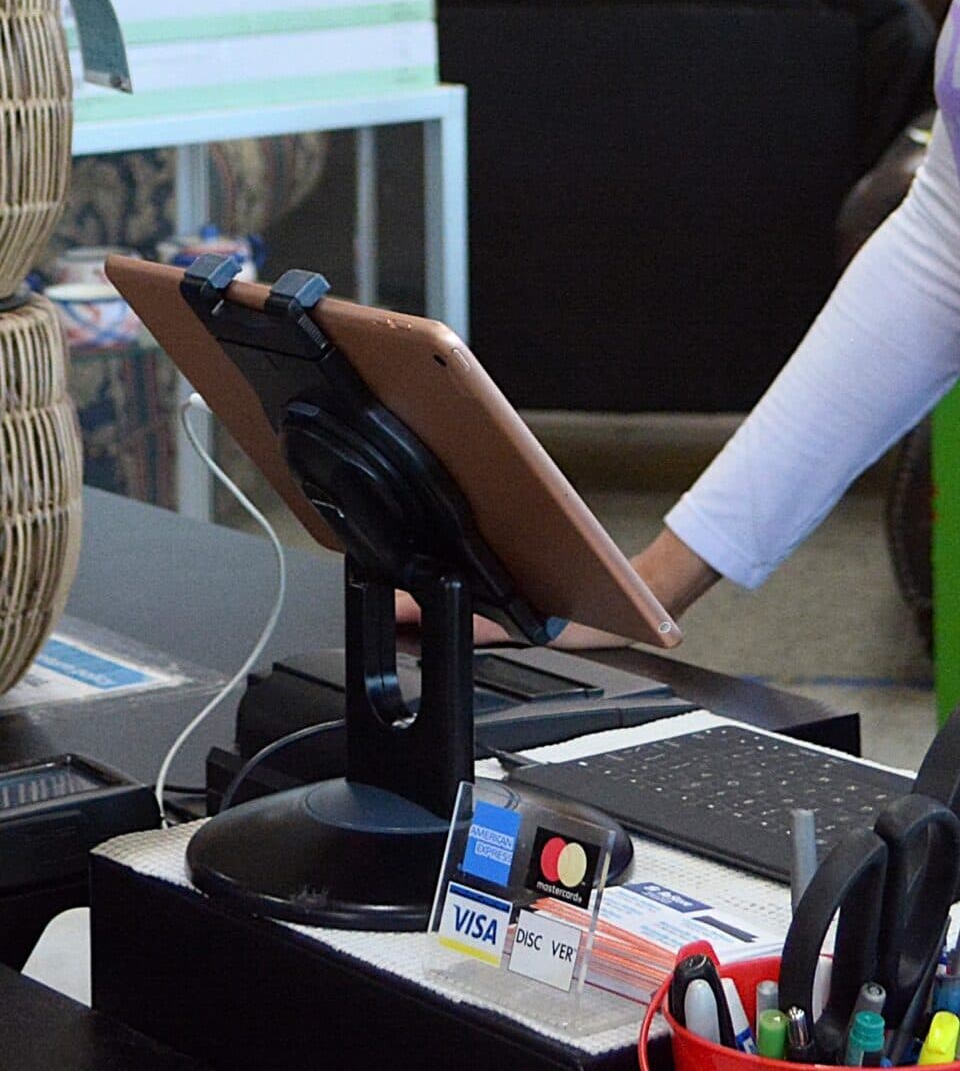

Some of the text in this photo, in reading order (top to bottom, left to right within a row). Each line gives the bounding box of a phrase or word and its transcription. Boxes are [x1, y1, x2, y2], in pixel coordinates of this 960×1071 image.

[469, 824, 515, 850] AMERICAN
[474, 840, 513, 866] EXPRESS
[536, 880, 579, 902] mastercard
[453, 903, 499, 946] VISA
